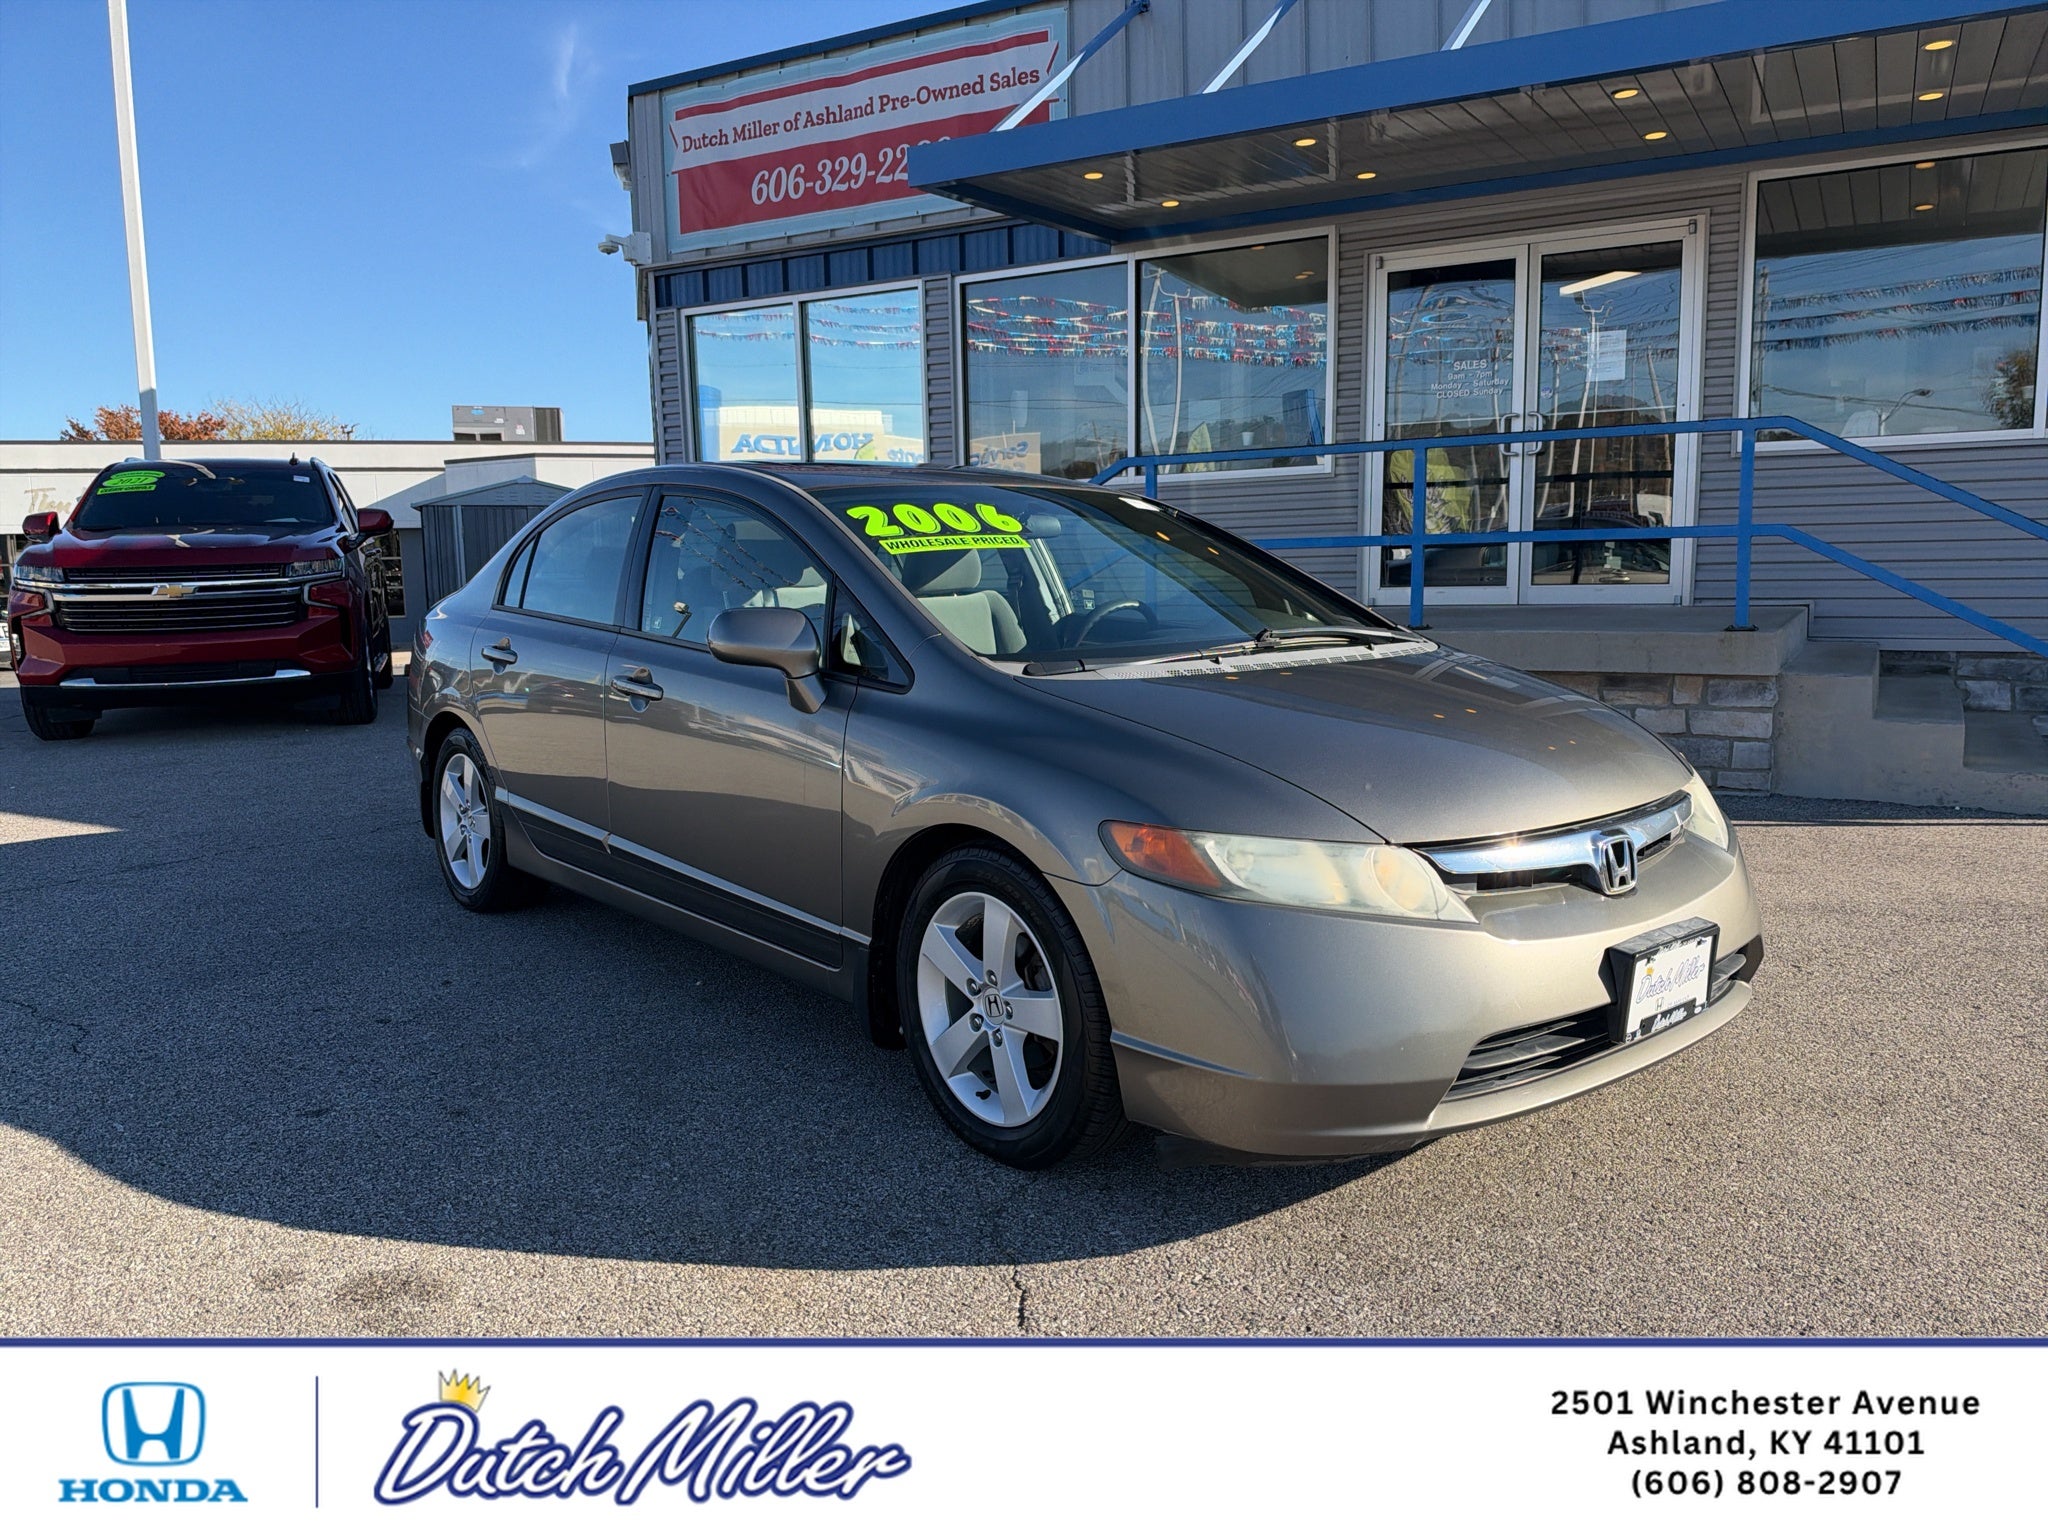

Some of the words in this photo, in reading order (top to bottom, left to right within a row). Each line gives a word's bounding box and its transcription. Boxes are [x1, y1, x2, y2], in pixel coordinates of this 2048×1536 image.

[682, 127, 729, 153] Dutch
[732, 119, 780, 144] Miller
[783, 112, 801, 132] of
[802, 97, 876, 129] Ashland
[878, 72, 985, 113] Pre-Owned
[989, 67, 1040, 93] Sales
[751, 136, 952, 206] 606-329-22
[1453, 359, 1488, 371] SALES
[1475, 371, 1493, 380] 7pm
[1431, 382, 1462, 391] Monday
[1473, 378, 1509, 388] Saturday
[1436, 389, 1470, 399] CLOSED
[1473, 386, 1504, 396] Sunday
[846, 503, 1023, 537] 2006
[885, 537, 971, 551] WHOLESALE
[973, 536, 1020, 546] PRICED
[1636, 967, 1674, 1004] Dutch
[1671, 955, 1706, 988] Miller
